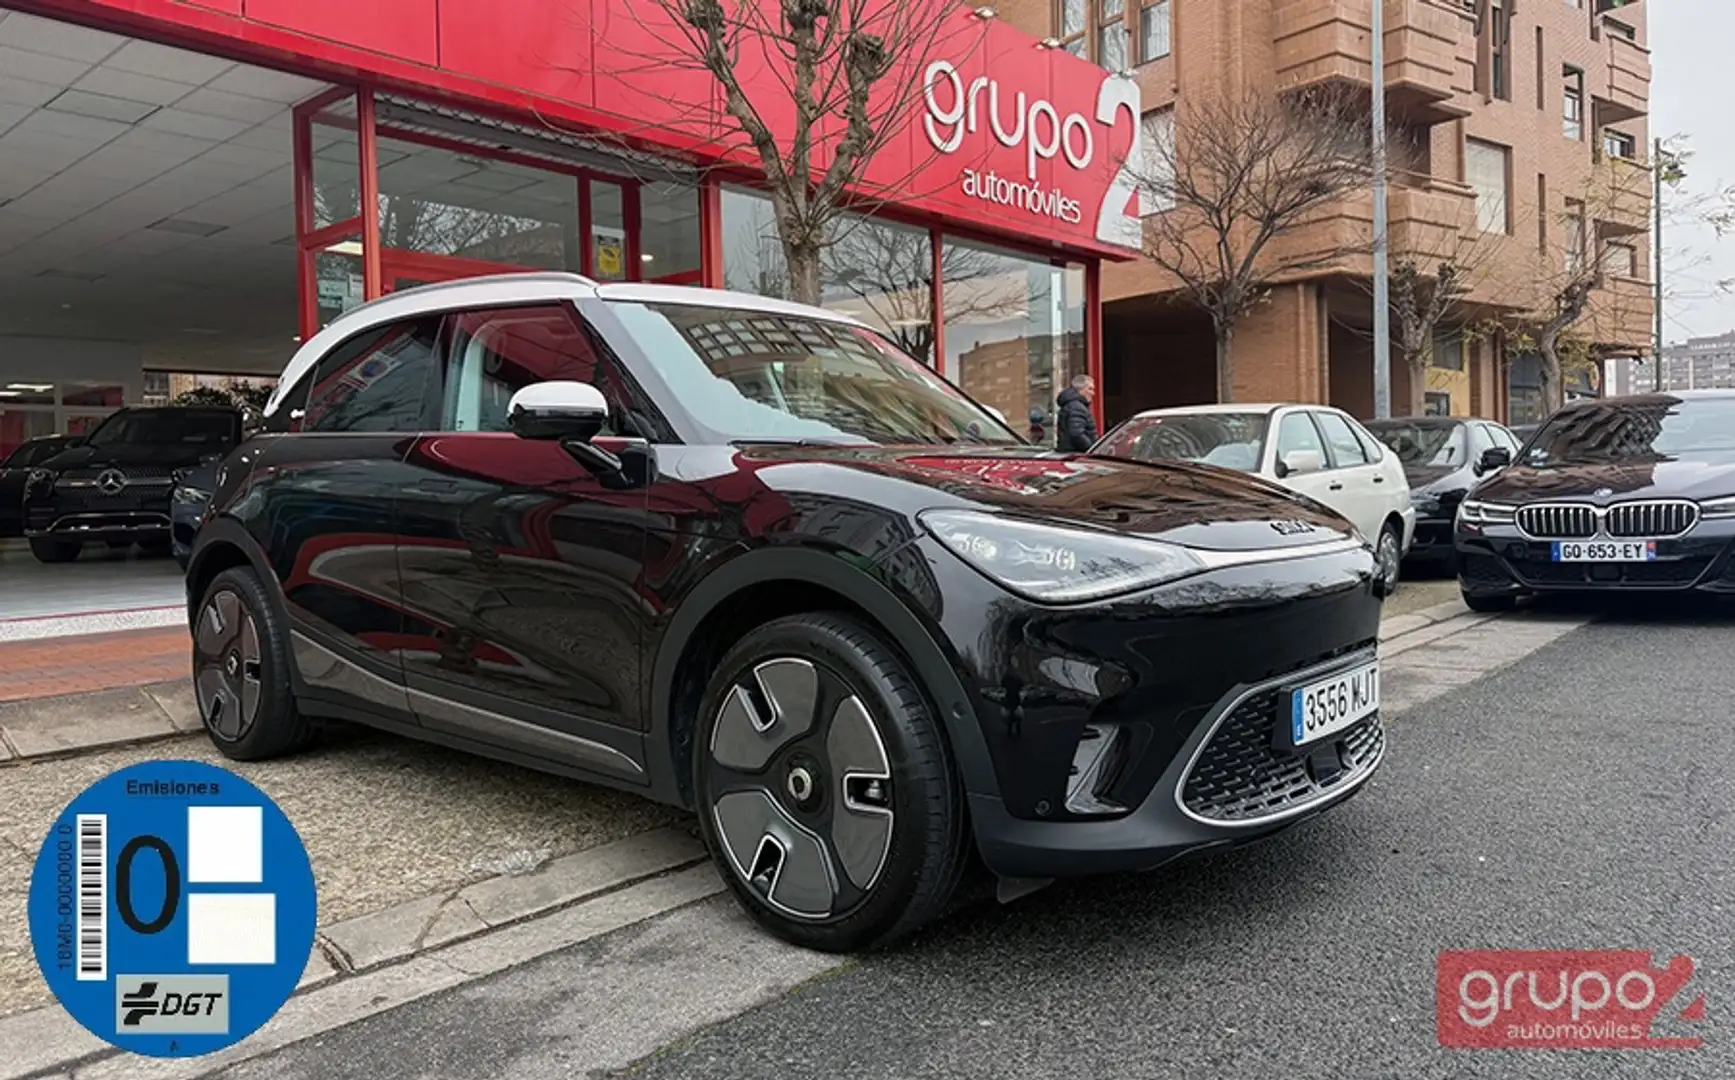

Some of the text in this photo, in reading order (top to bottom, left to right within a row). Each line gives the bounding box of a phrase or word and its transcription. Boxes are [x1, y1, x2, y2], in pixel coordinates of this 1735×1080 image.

[925, 60, 1142, 249] grupo 2
[962, 168, 1081, 224] automóviles
[1306, 681, 1348, 731] 3556
